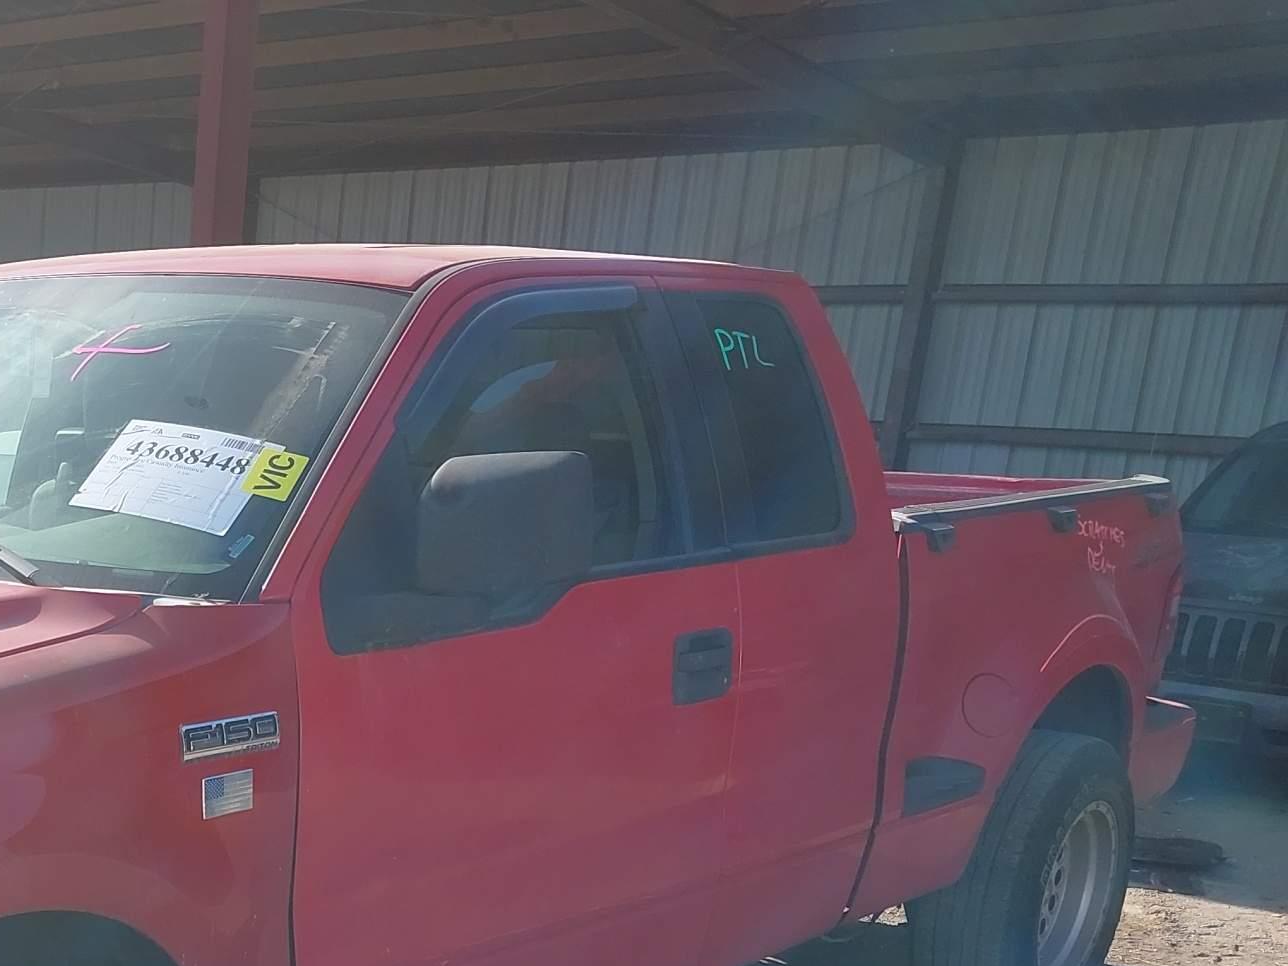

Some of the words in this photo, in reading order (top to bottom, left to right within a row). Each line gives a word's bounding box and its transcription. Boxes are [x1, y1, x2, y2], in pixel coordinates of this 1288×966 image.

[714, 328, 775, 370] PTL
[126, 440, 250, 475] 43688448
[252, 454, 295, 490] VIC
